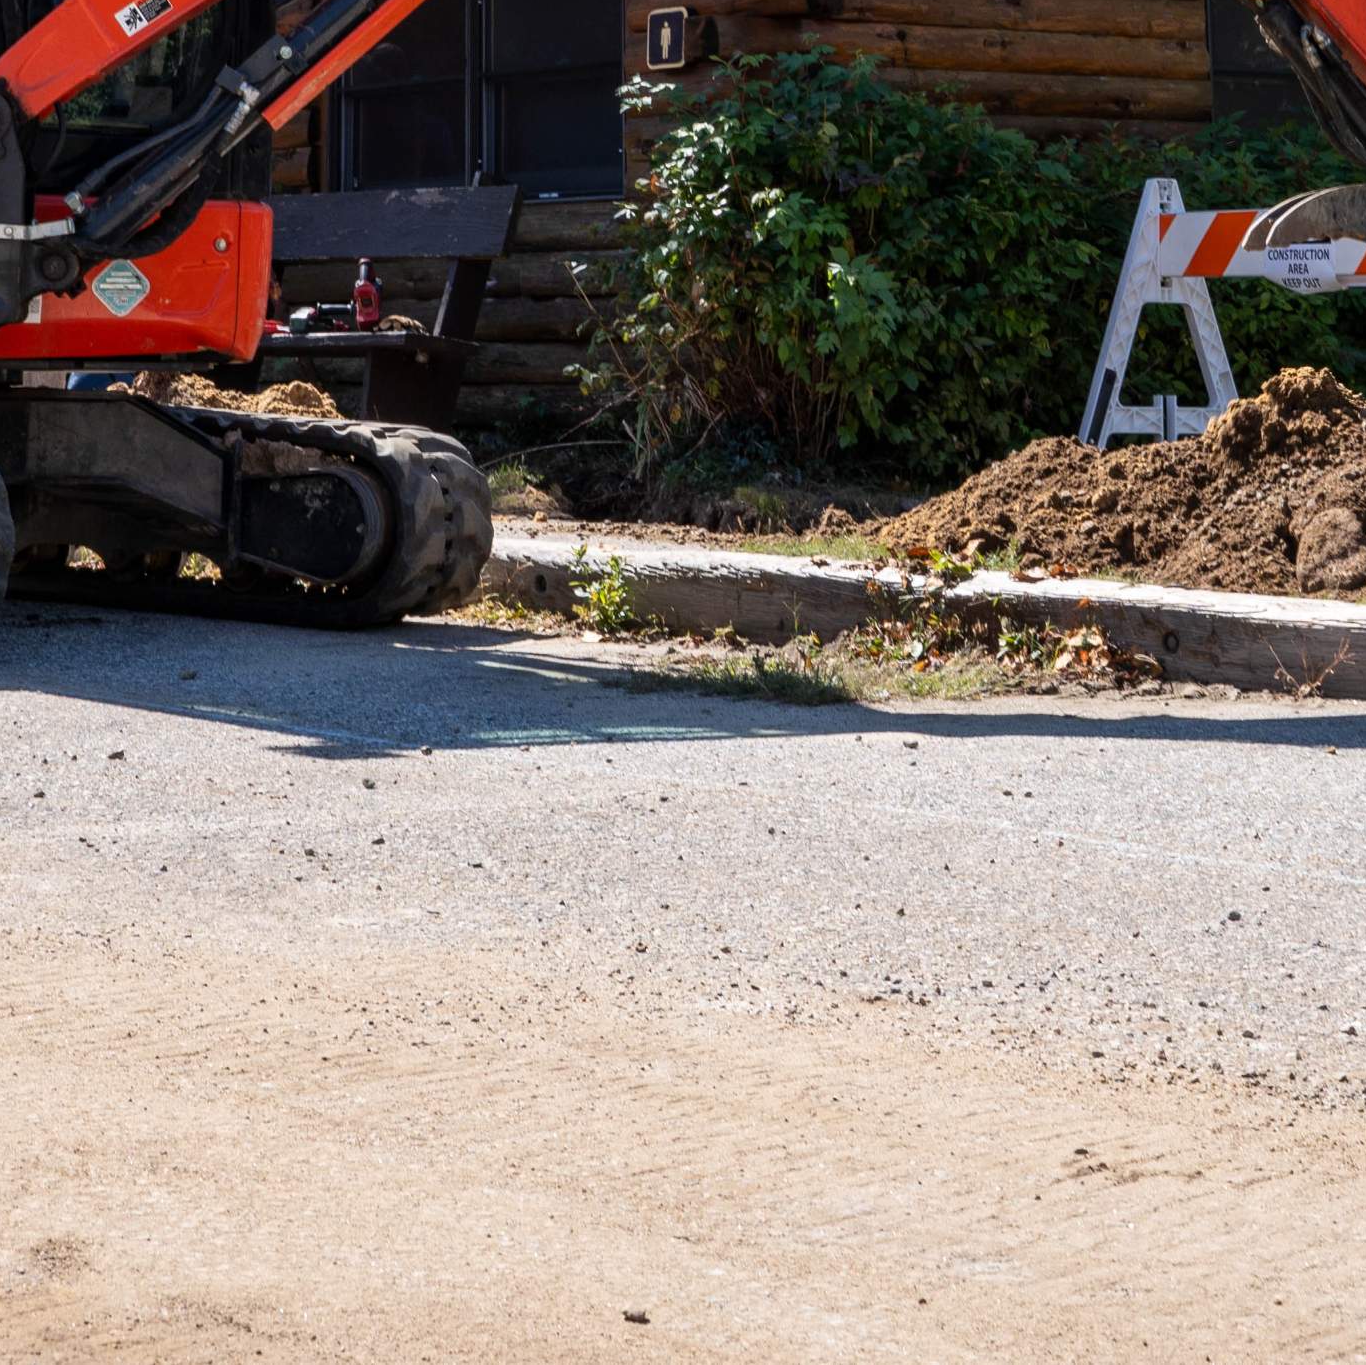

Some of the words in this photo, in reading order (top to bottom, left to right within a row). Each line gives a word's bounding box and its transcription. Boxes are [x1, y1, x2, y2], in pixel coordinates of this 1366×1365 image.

[1267, 248, 1330, 261] CONSTRUCTION
[1288, 263, 1309, 275] AREA
[1282, 277, 1302, 288] KEEP
[1303, 277, 1323, 289] OUT
